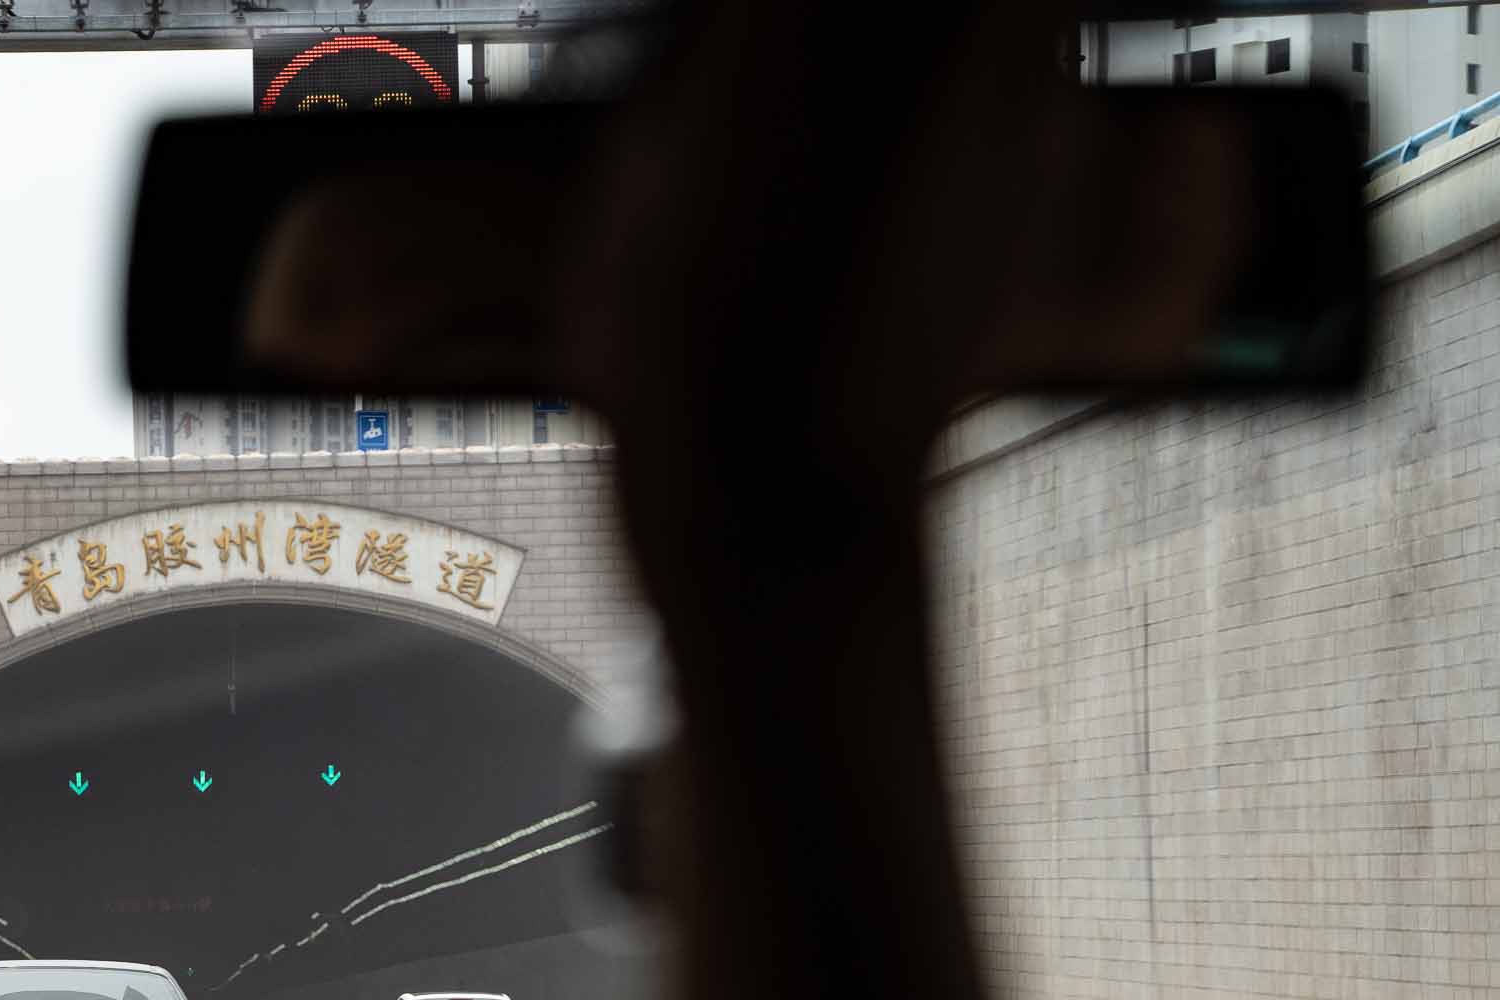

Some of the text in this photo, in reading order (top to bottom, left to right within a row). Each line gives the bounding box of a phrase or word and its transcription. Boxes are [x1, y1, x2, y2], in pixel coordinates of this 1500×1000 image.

[8, 513, 498, 615] 青岛胶州湾隧道
